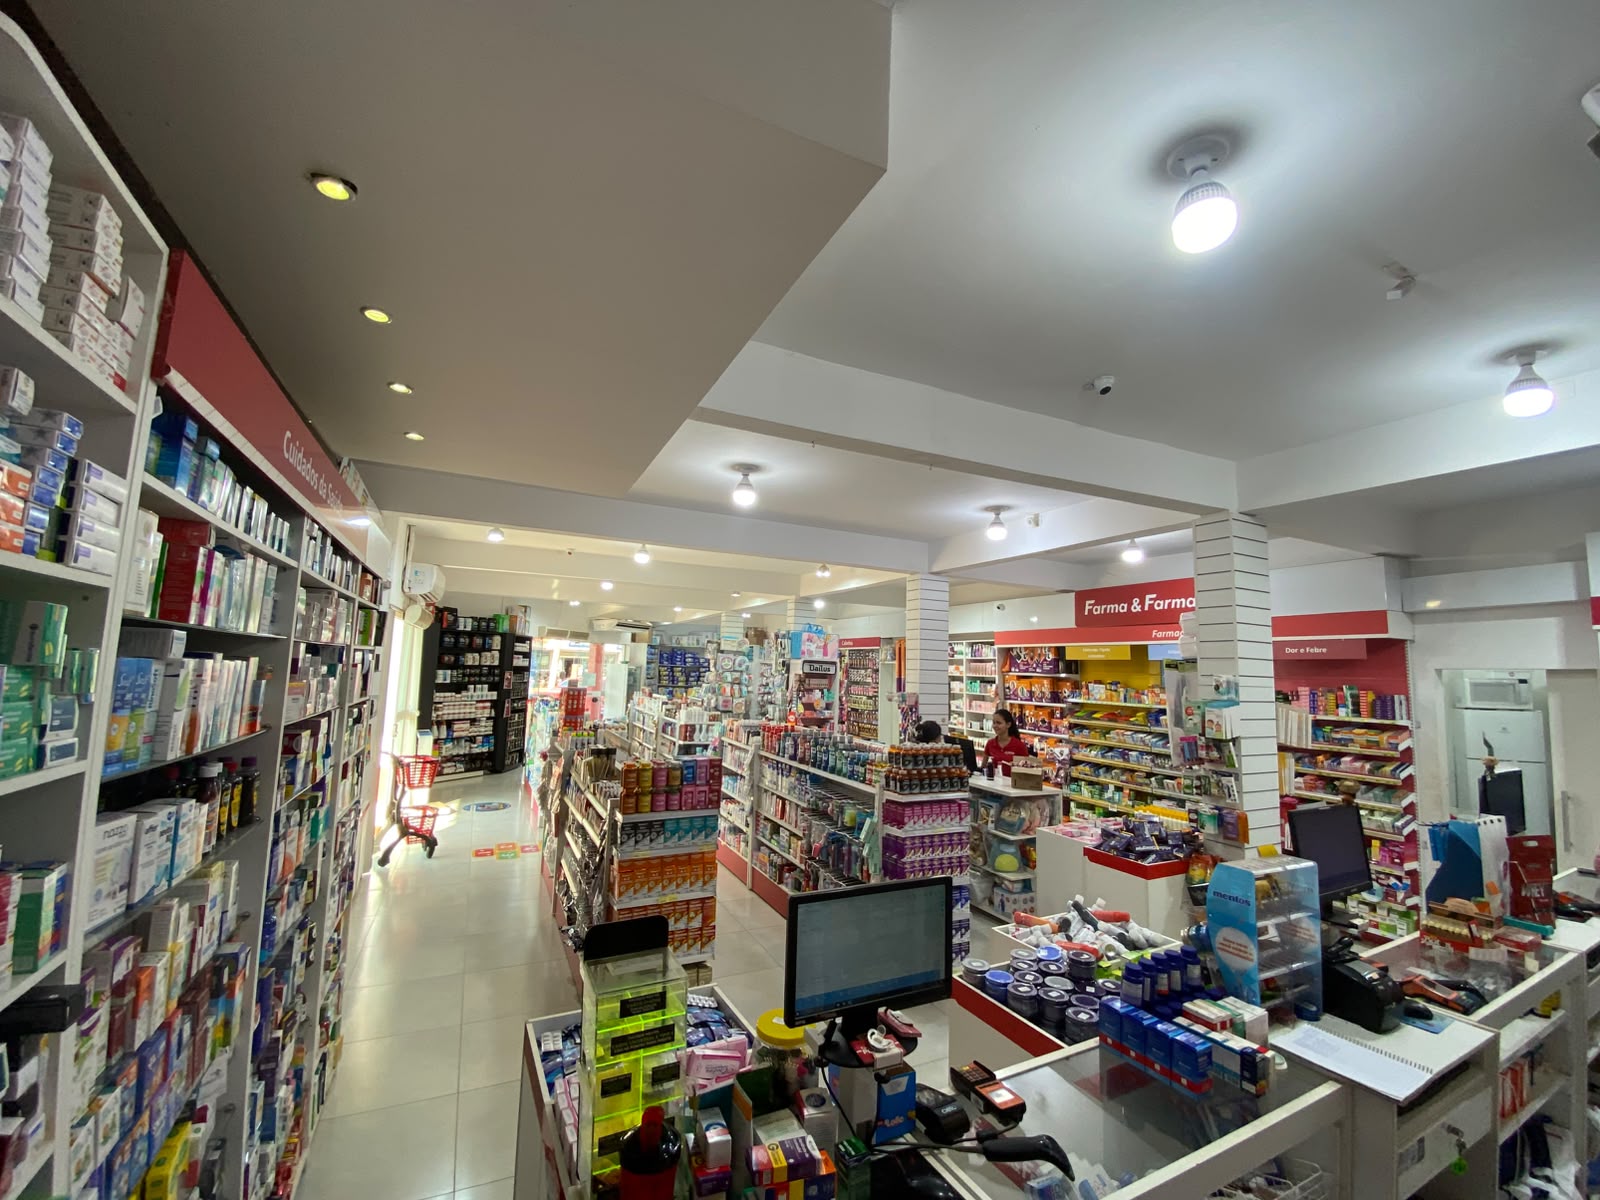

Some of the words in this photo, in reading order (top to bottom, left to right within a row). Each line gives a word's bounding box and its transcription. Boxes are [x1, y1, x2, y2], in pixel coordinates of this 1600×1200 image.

[283, 430, 319, 491] Cuidados
[319, 473, 327, 499] da
[1084, 599, 1128, 616] Farma
[1131, 597, 1142, 613] &
[1144, 593, 1196, 611] Farma
[809, 664, 831, 672] Dailus
[1213, 890, 1251, 907] mentos
